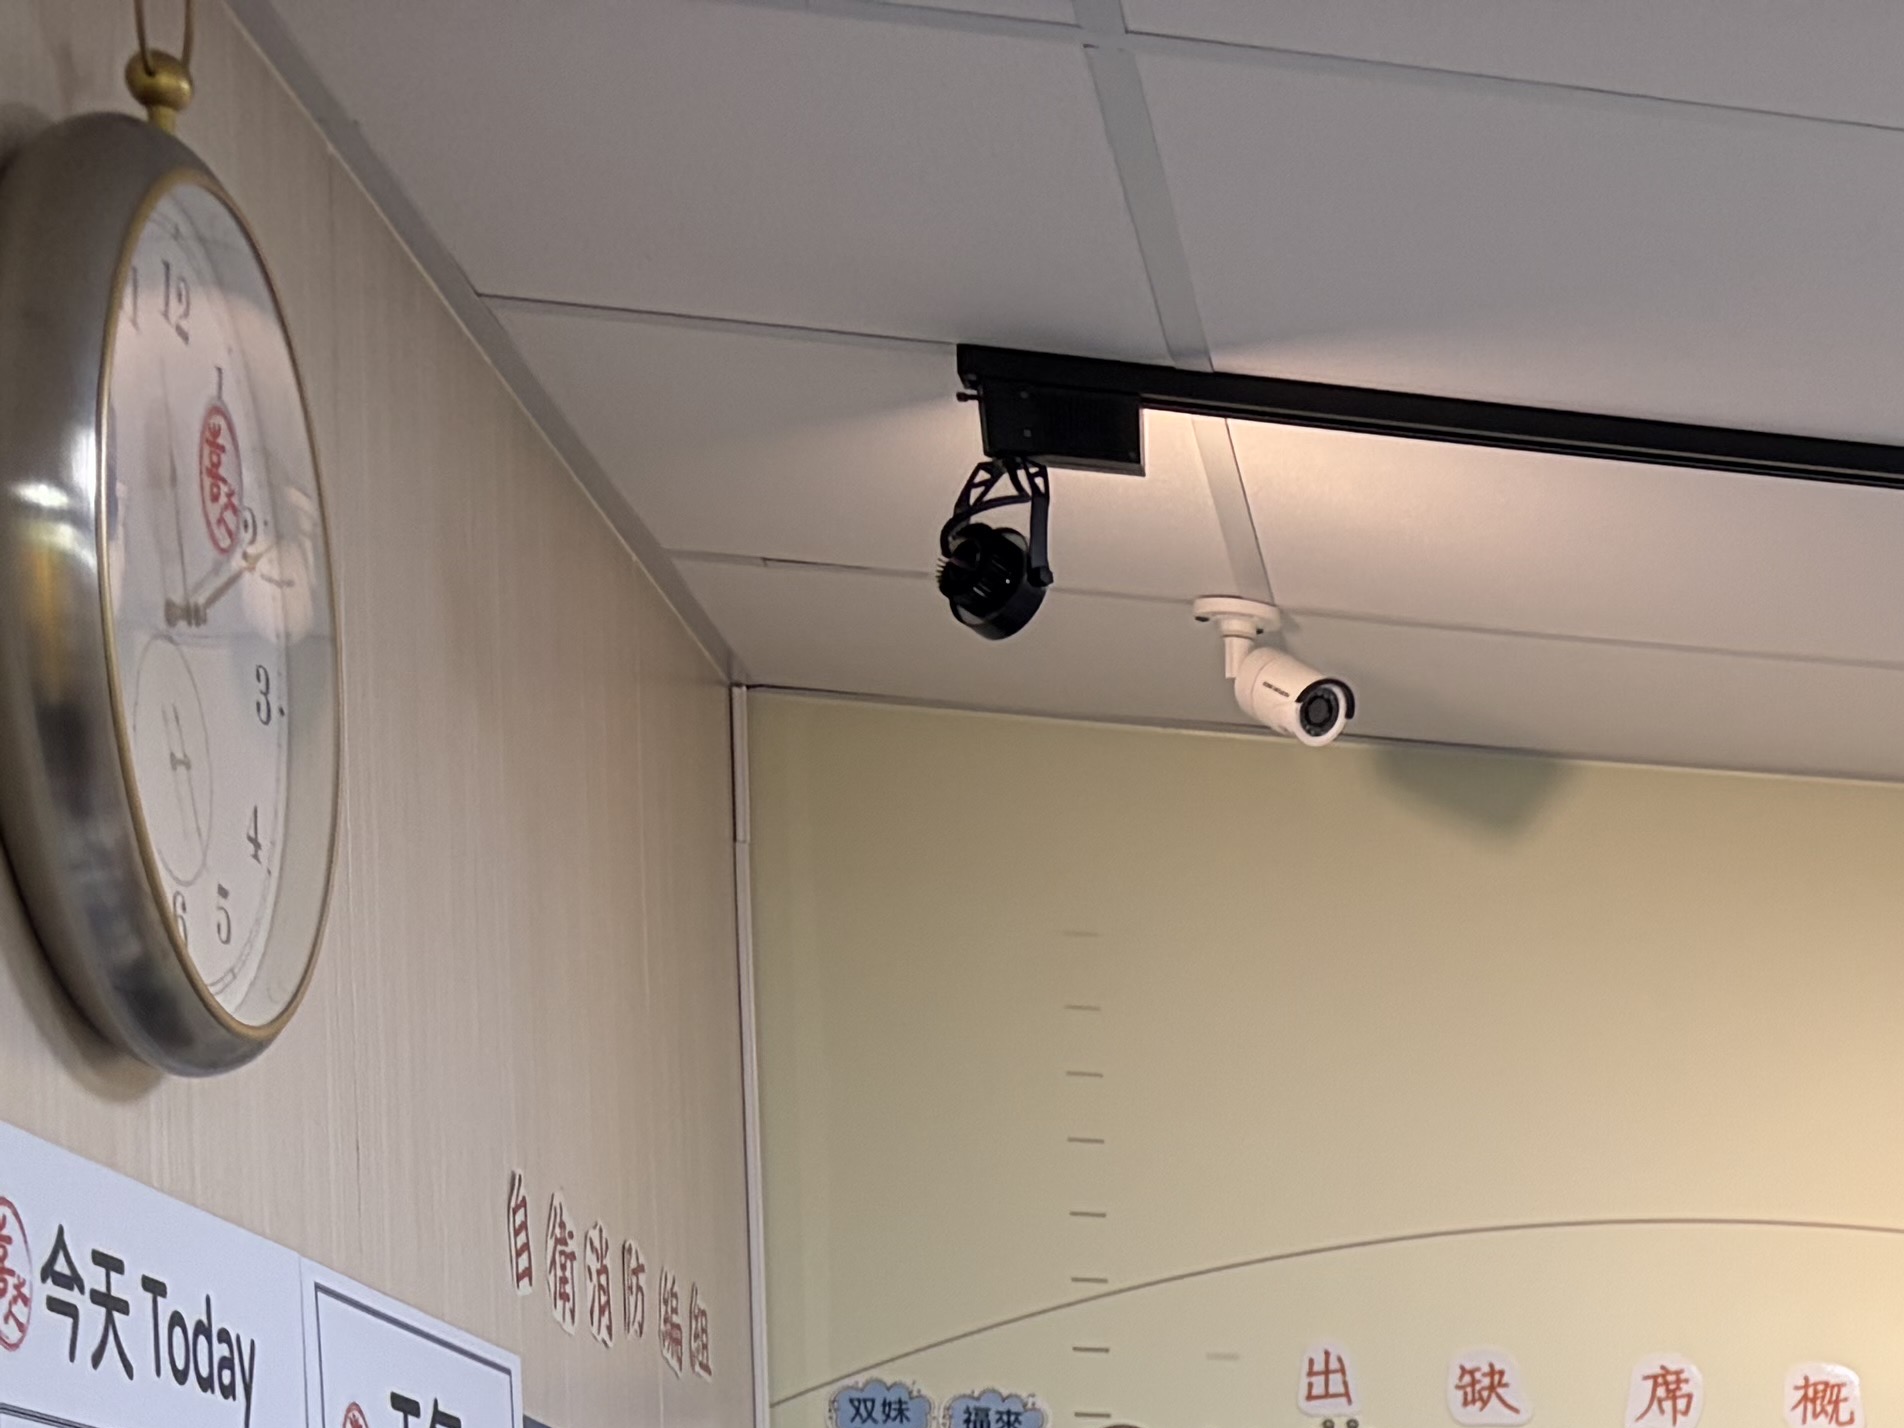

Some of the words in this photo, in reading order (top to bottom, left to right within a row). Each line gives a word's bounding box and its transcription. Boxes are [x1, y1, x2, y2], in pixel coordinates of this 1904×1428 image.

[255, 663, 271, 727] 3
[246, 805, 263, 864] 4
[40, 1225, 134, 1380] 今天
[508, 1171, 713, 1380] 自衛消防編組
[848, 1397, 911, 1425] 双妹
